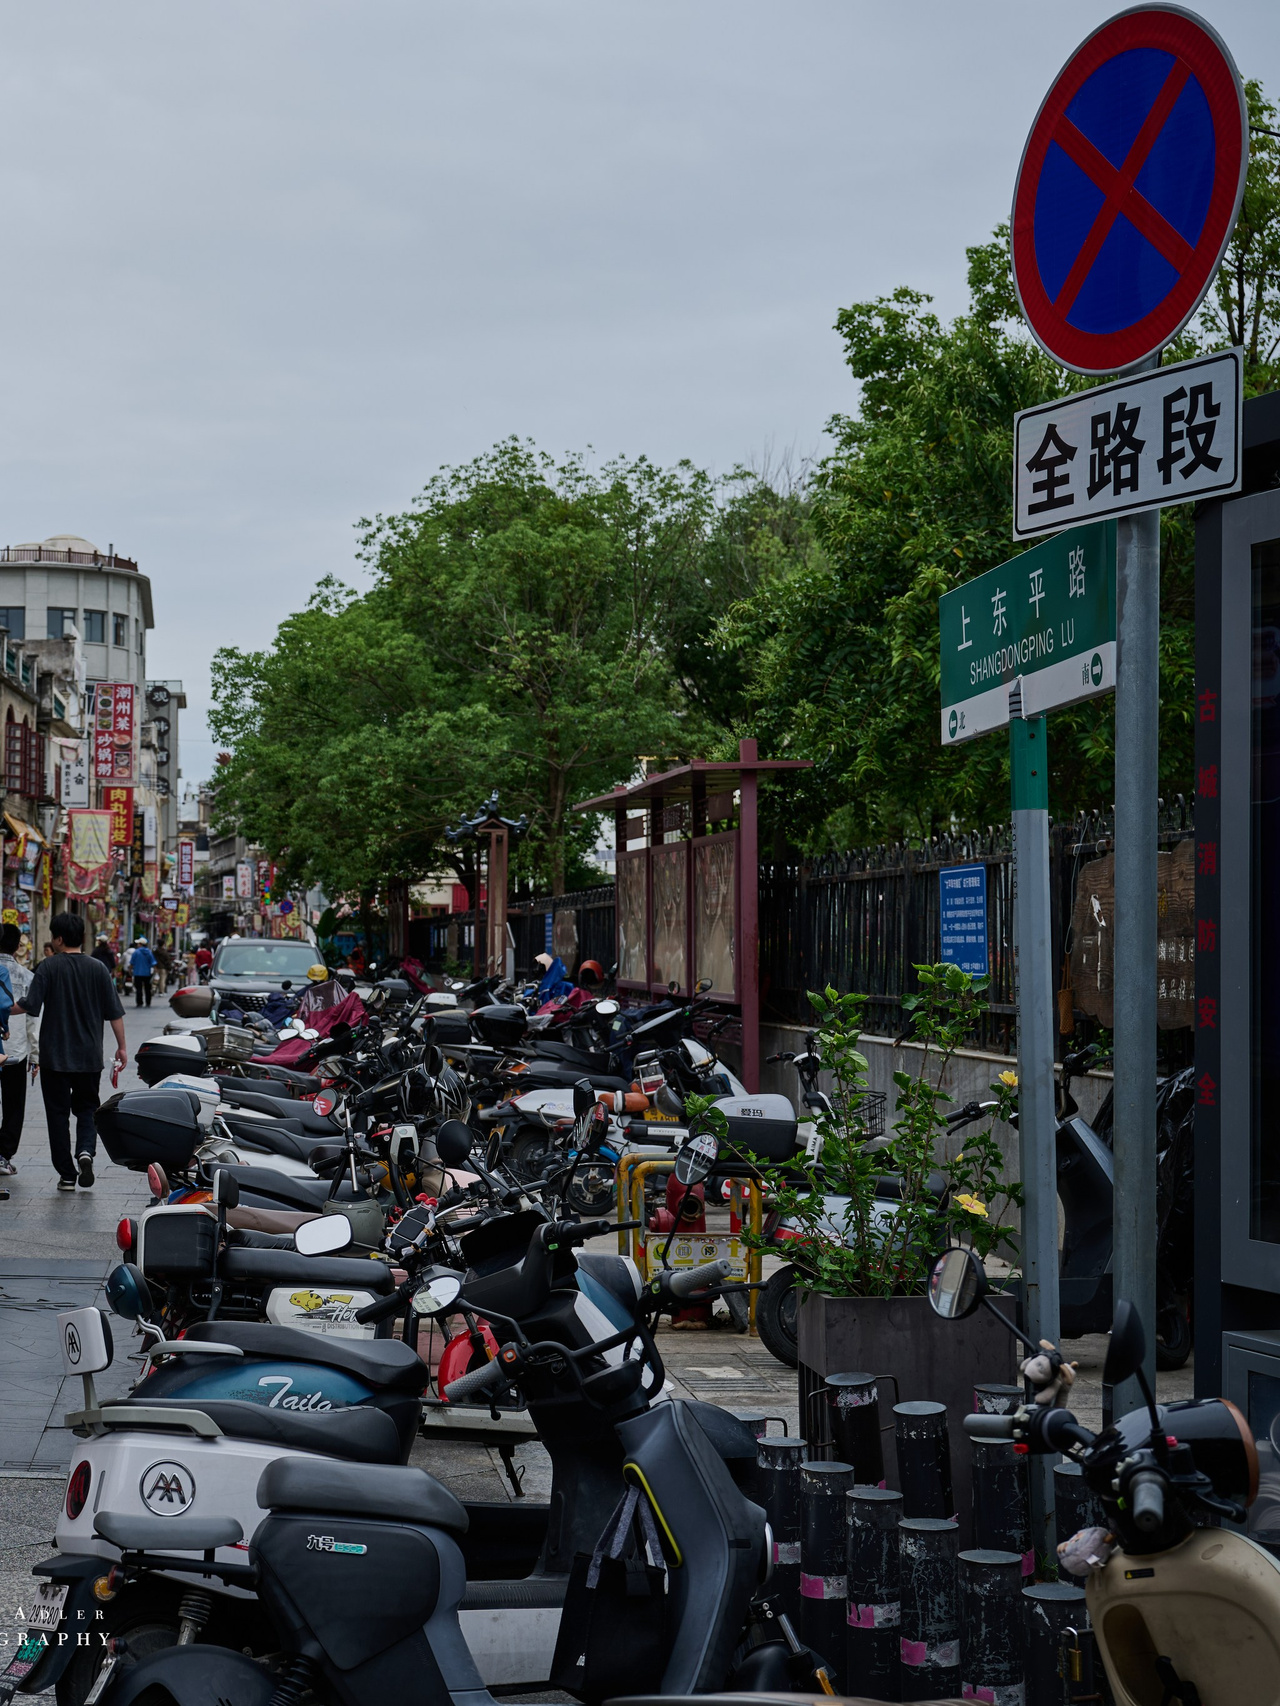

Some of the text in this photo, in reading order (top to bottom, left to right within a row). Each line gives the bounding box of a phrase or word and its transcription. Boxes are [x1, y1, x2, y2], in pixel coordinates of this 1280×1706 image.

[1026, 381, 1223, 515] 全路段
[958, 545, 1086, 652] 上东平路
[970, 618, 1075, 685] SHANGDONGPING LU
[1081, 662, 1090, 685] 南
[116, 686, 131, 731] 潮州菜
[959, 710, 966, 731] 北
[97, 733, 113, 777] 砂锅粥
[1198, 688, 1217, 1105] 古城消防安全
[306, 1534, 334, 1551] 九号
